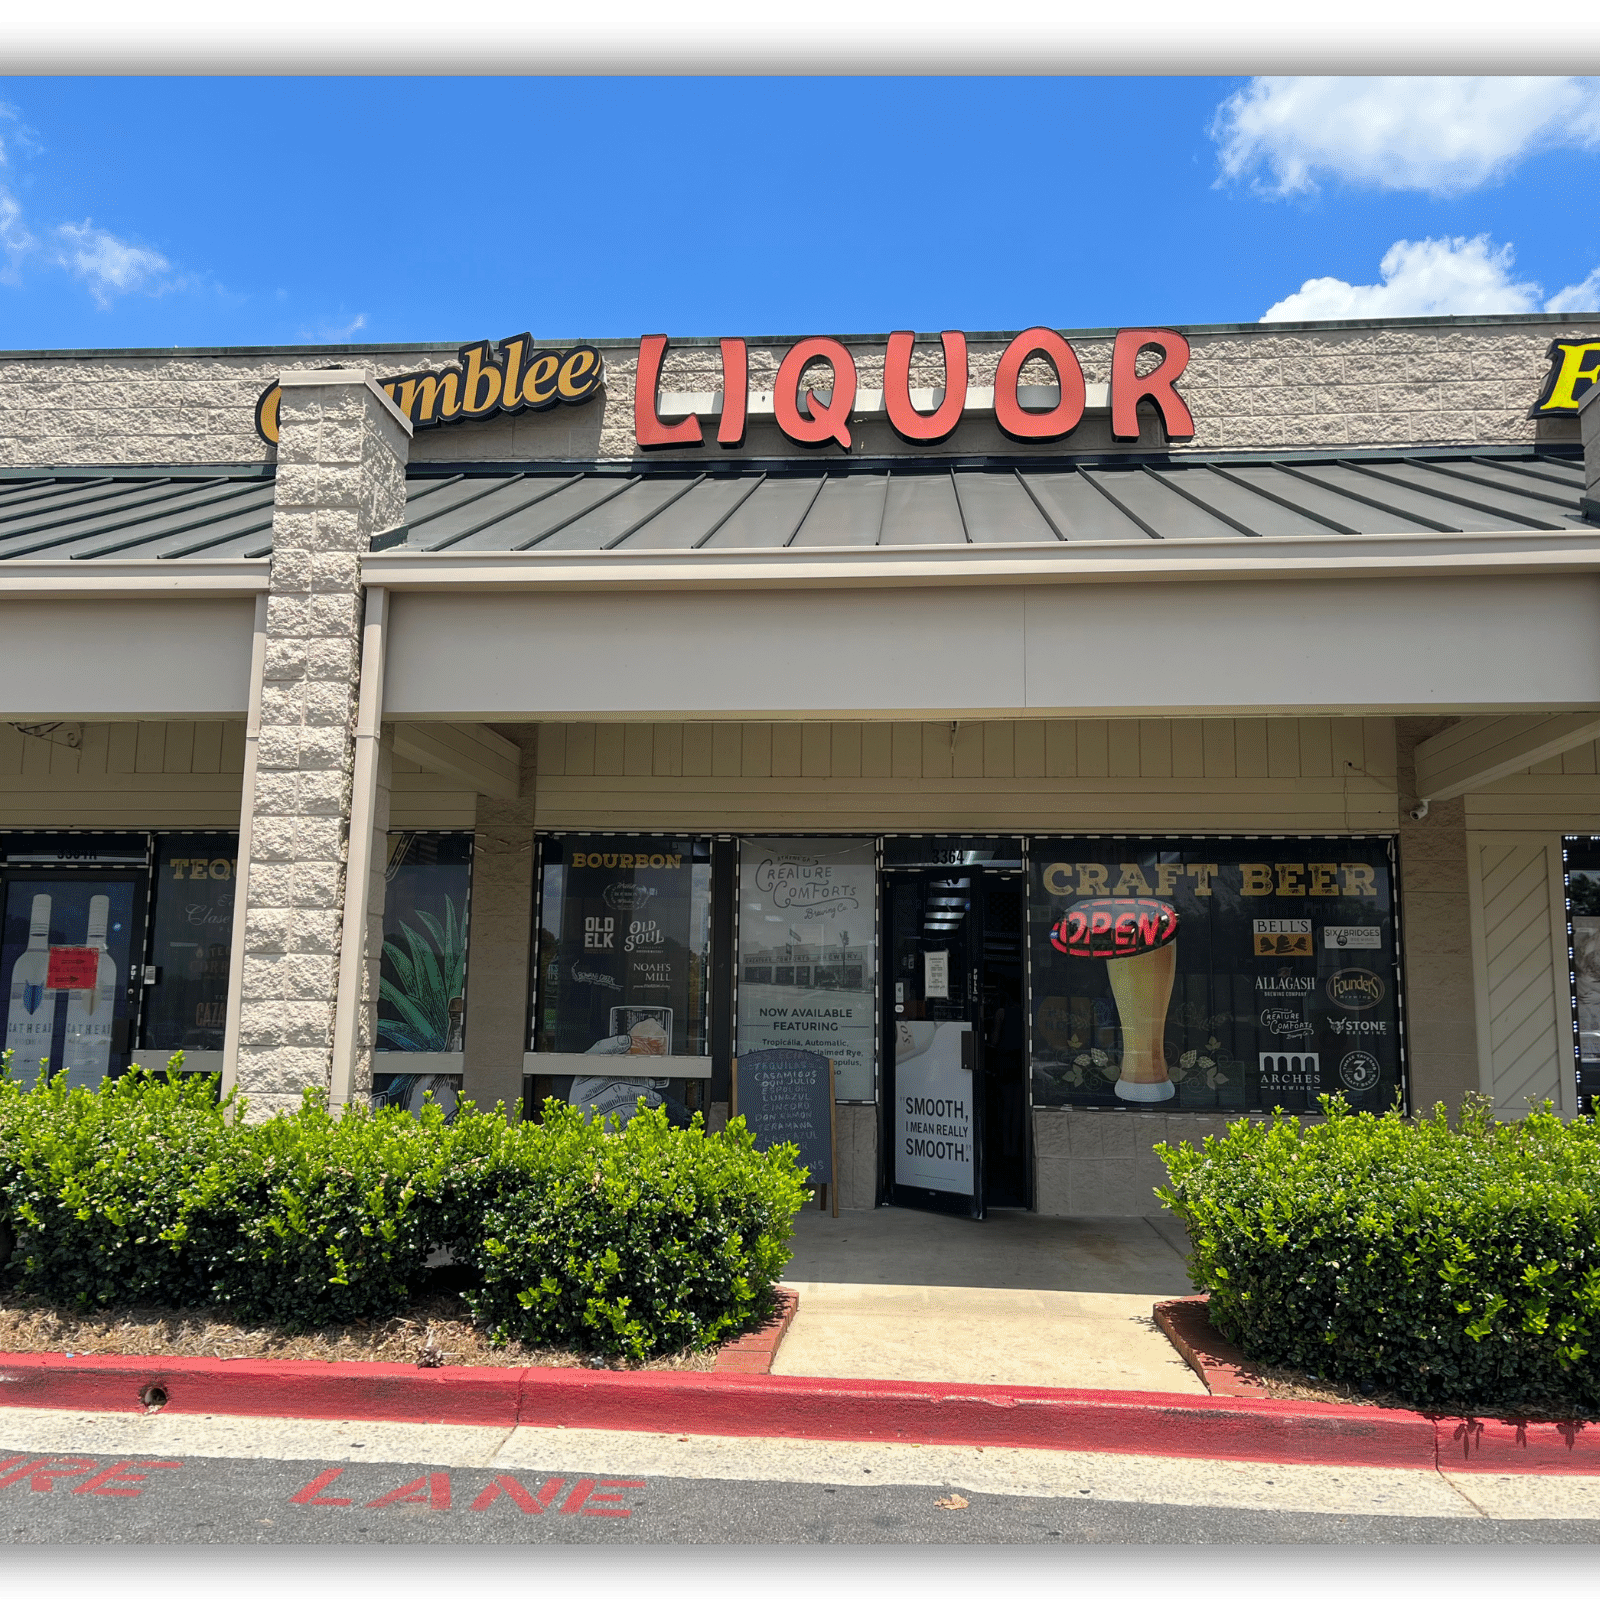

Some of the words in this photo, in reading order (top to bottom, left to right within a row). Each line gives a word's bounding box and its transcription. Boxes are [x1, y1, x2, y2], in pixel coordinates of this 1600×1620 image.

[634, 326, 1195, 451] LIQUOR
[572, 853, 682, 868] BOURBON
[932, 849, 965, 865] 3364
[755, 859, 832, 892] CREATURE
[1043, 862, 1218, 896] CRAFT
[1239, 863, 1378, 896] BEER
[585, 917, 614, 932] OLD
[629, 920, 656, 935] OLD
[1058, 911, 1160, 946] OPEN
[1257, 920, 1309, 933] BELL'S
[584, 933, 613, 948] ELK
[624, 931, 665, 951] SOUL
[633, 963, 671, 971] NOAH'S
[645, 973, 670, 981] MILL
[1255, 976, 1316, 990] ALLAGASH
[1333, 975, 1379, 998] Founders
[759, 1007, 789, 1017] NOW
[791, 1008, 853, 1018] AVAILABLE
[773, 1021, 839, 1031] FEATURING
[1346, 1021, 1387, 1031] STONE
[805, 1038, 849, 1047] Automatic,
[1353, 1060, 1366, 1081] 3
[1260, 1074, 1320, 1083] ARCHES
[905, 1121, 909, 1132] I
[910, 1121, 934, 1134] MEAN
[936, 1124, 969, 1138] REALLY
[290, 1468, 645, 1517] LANE
